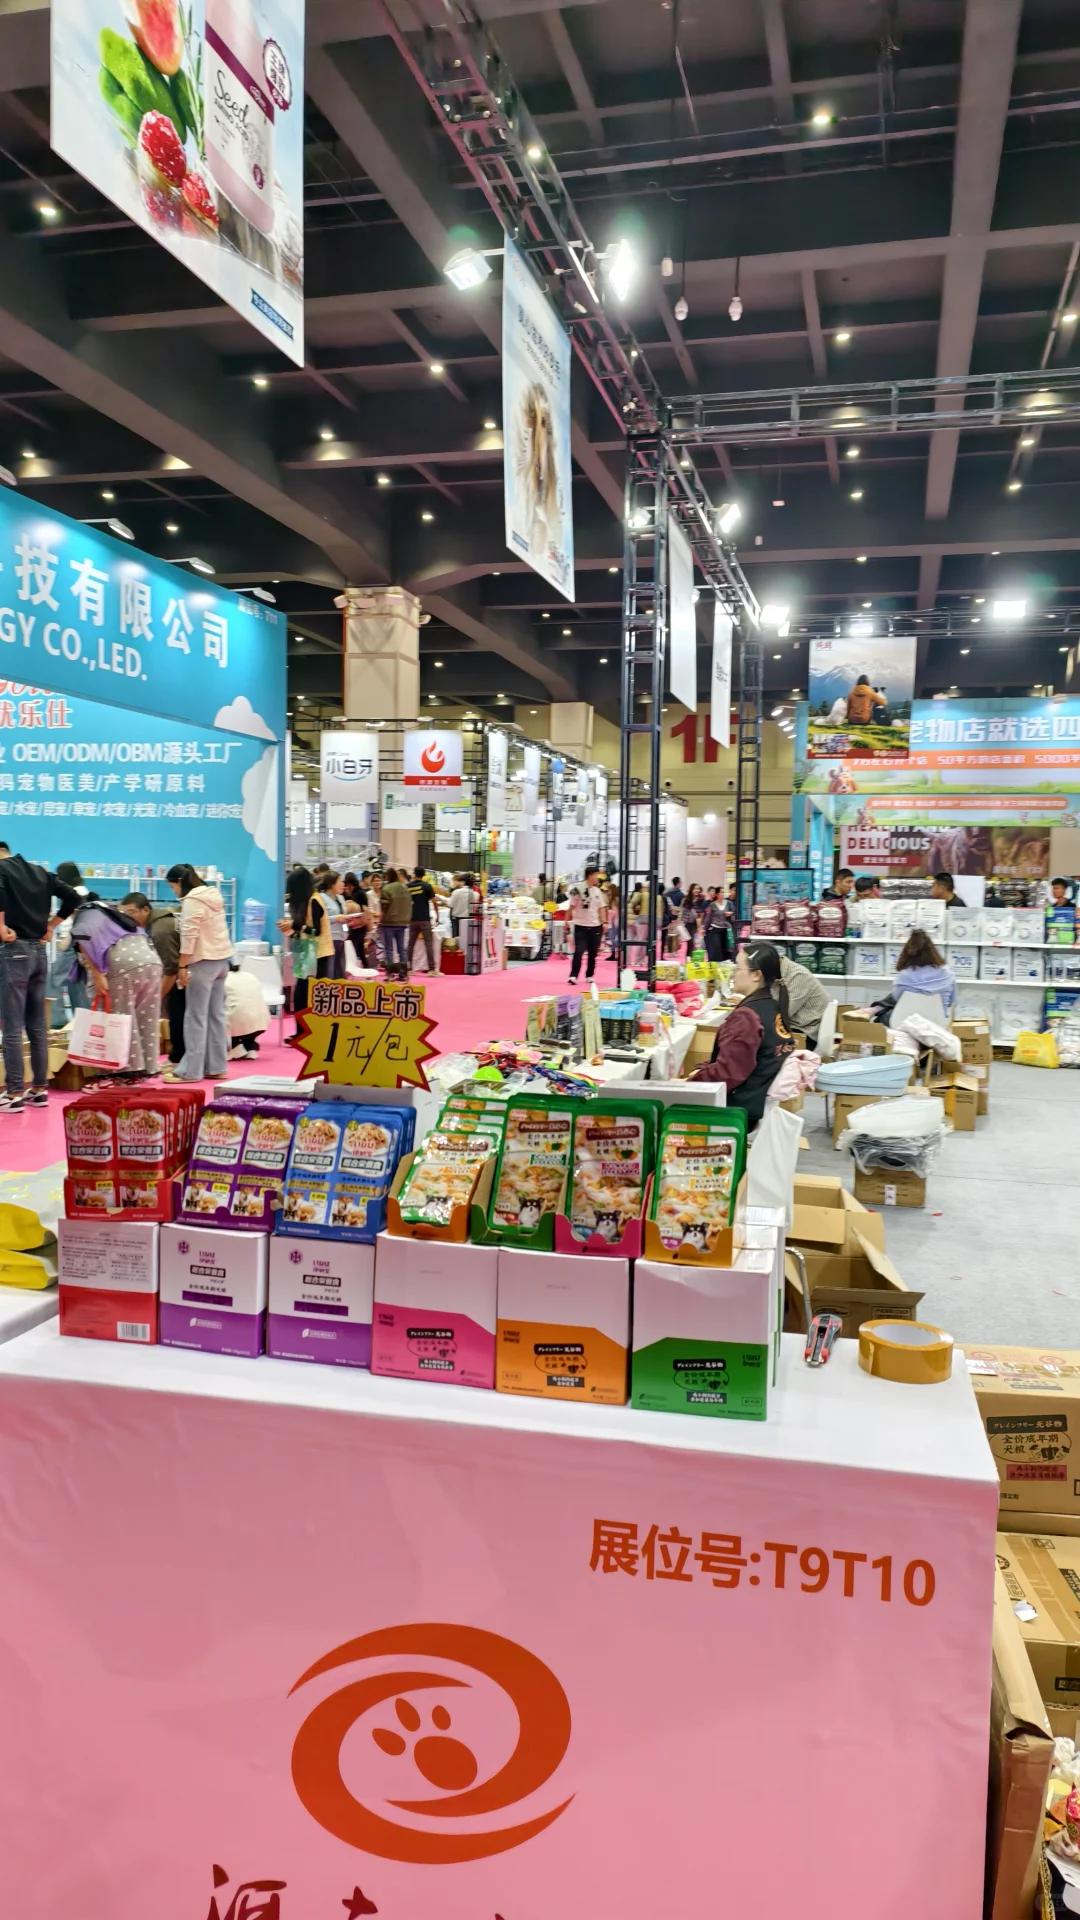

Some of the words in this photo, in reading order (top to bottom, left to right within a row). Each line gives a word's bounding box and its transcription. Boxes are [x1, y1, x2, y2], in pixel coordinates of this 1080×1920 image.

[214, 70, 251, 128] Seed
[0, 533, 229, 669] 技有限公司
[43, 622, 147, 681] CO.,LED.
[12, 741, 243, 765] OEM/ODM/OBM源头工厂
[325, 758, 374, 775] 小白牙
[847, 837, 930, 850] DELICIOUS
[312, 983, 423, 1020] 新品上市
[323, 1018, 409, 1075] 1元/包
[1002, 1434, 1059, 1444] 全价成年期
[588, 1518, 937, 1607] 展位号:T9T10
